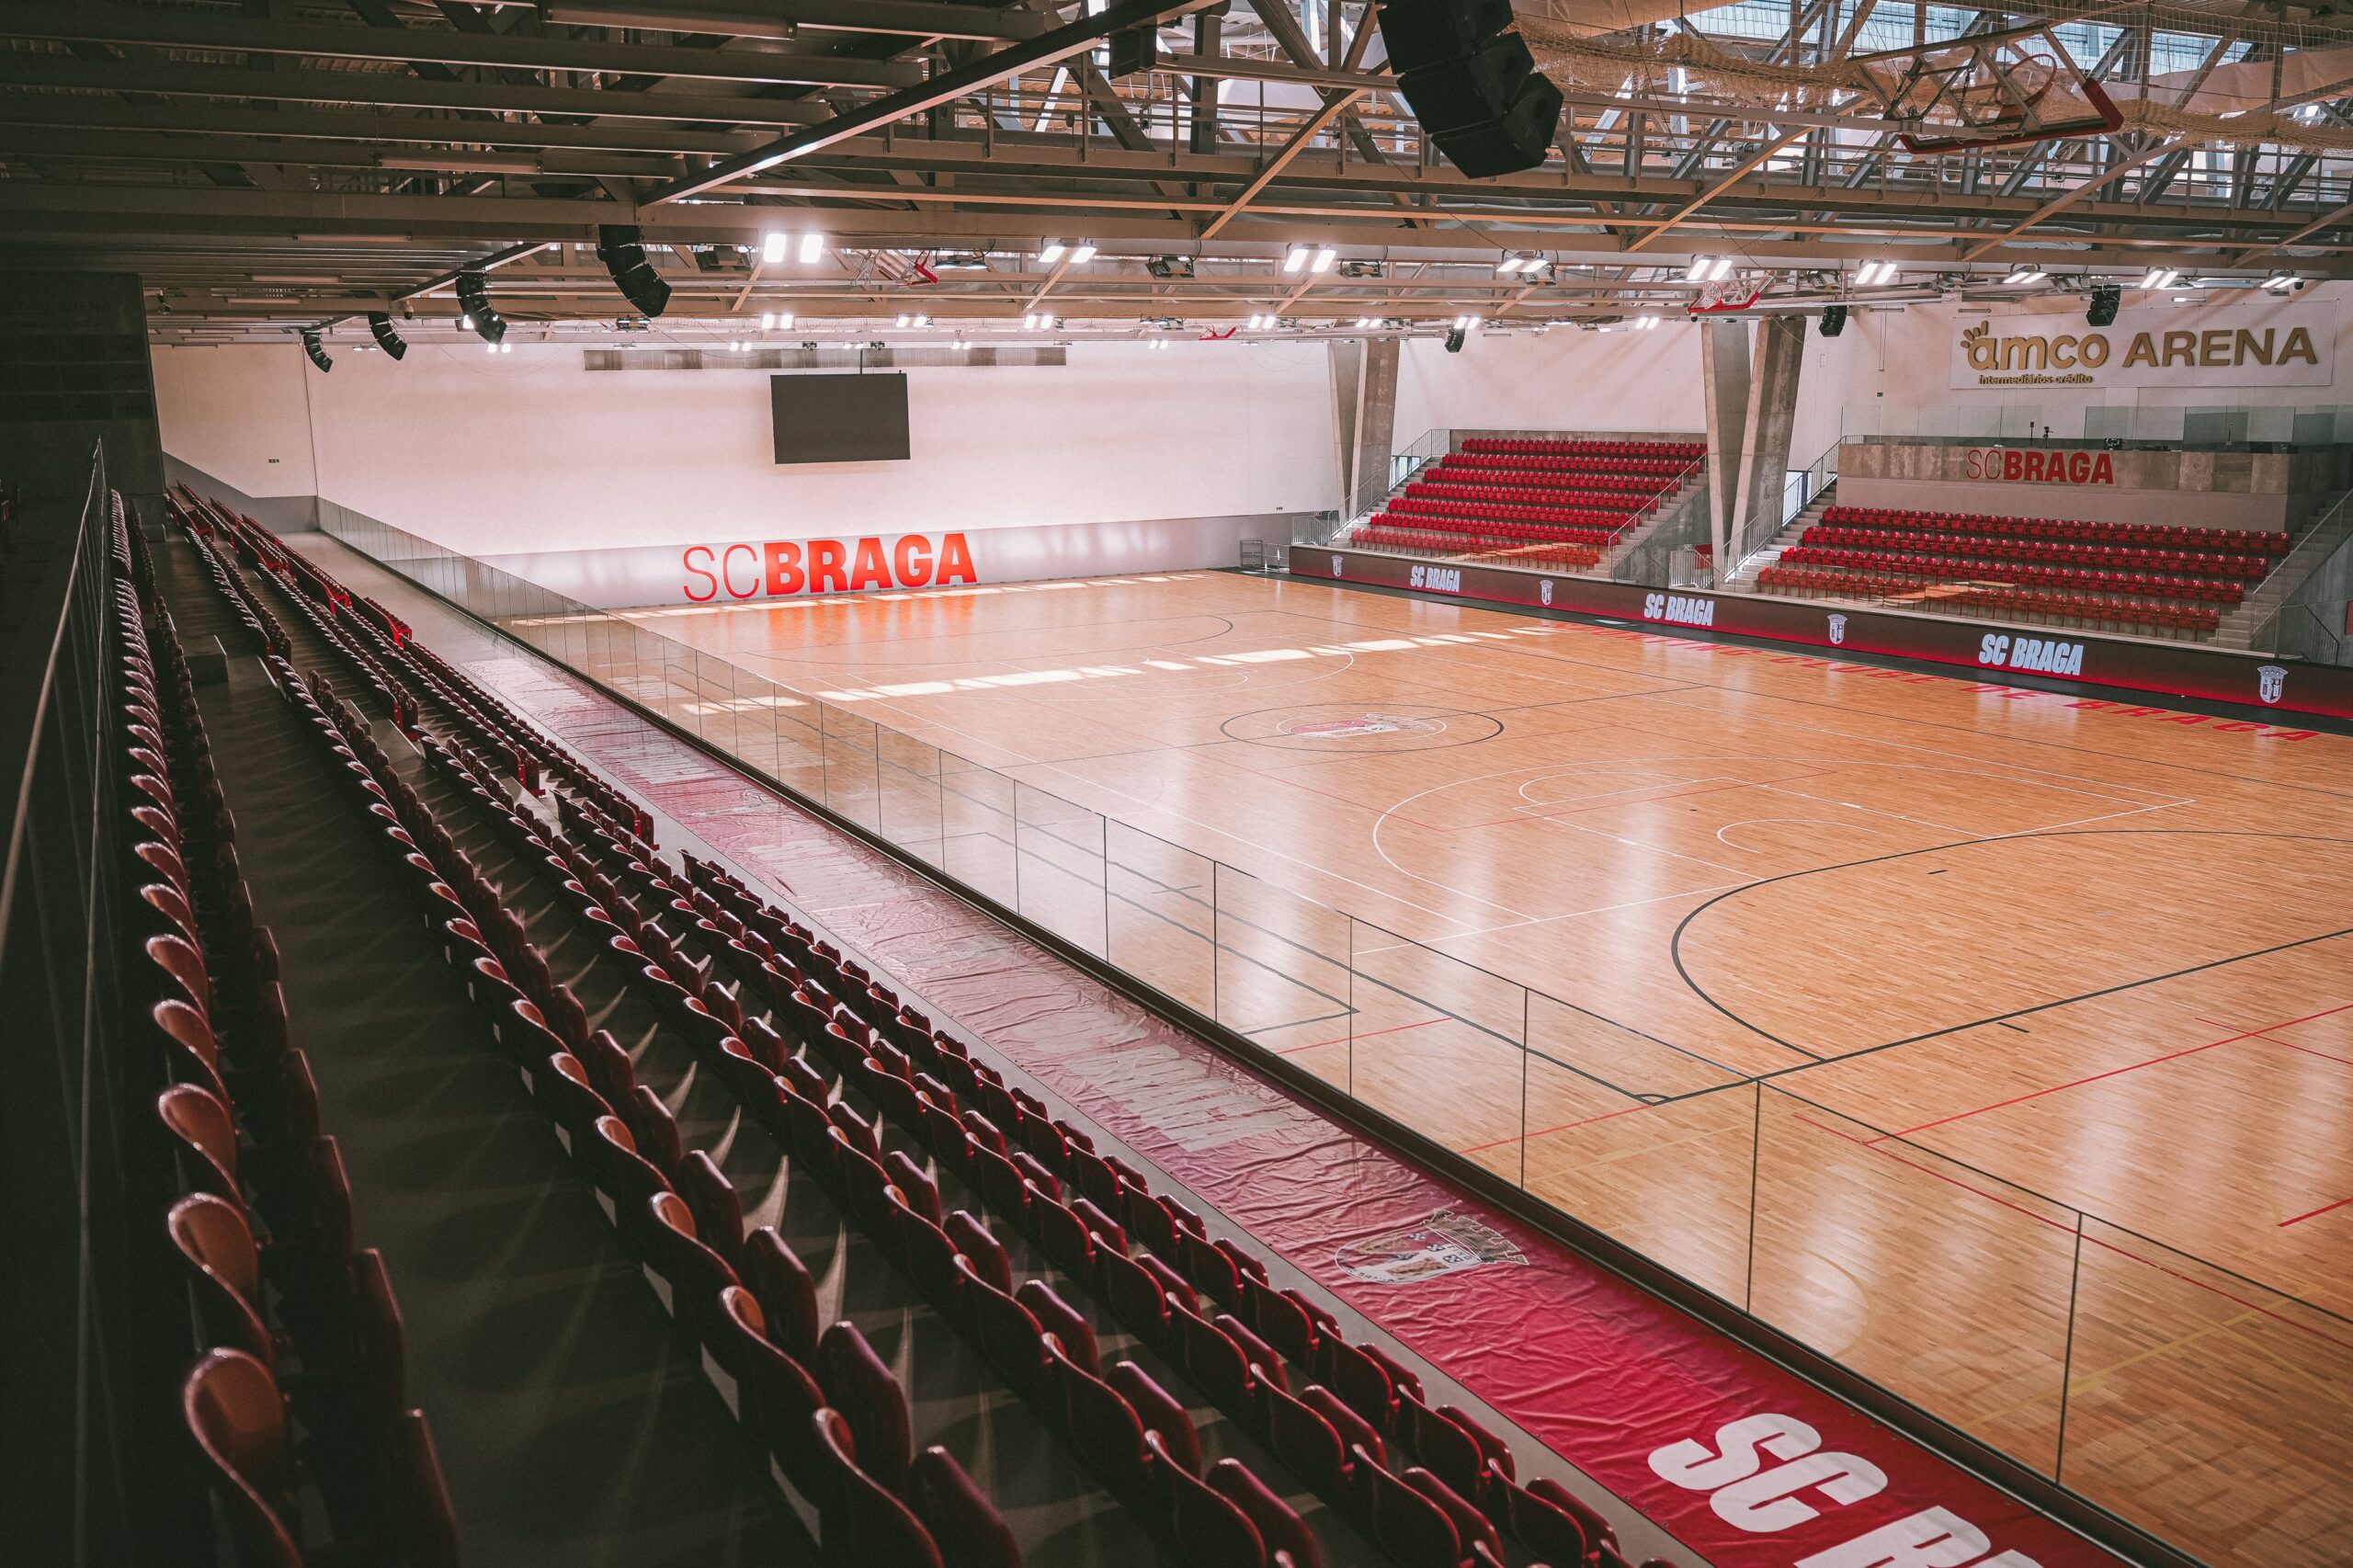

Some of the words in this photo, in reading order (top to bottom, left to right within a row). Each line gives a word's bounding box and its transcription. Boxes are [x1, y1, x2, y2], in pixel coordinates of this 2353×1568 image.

[1967, 331, 2110, 370] amco
[2121, 326, 2318, 368] ARENA
[1410, 565, 1425, 587] SC
[1426, 567, 1461, 593] BRAGA
[1643, 593, 1665, 619] SC
[1665, 596, 1714, 626] BRAGA
[1978, 633, 2009, 665] SC
[2009, 637, 2084, 676] BRAGA
[1957, 684, 2053, 700] DE
[2063, 700, 2323, 742] BRAGA
[1647, 1413, 1889, 1533] SC
